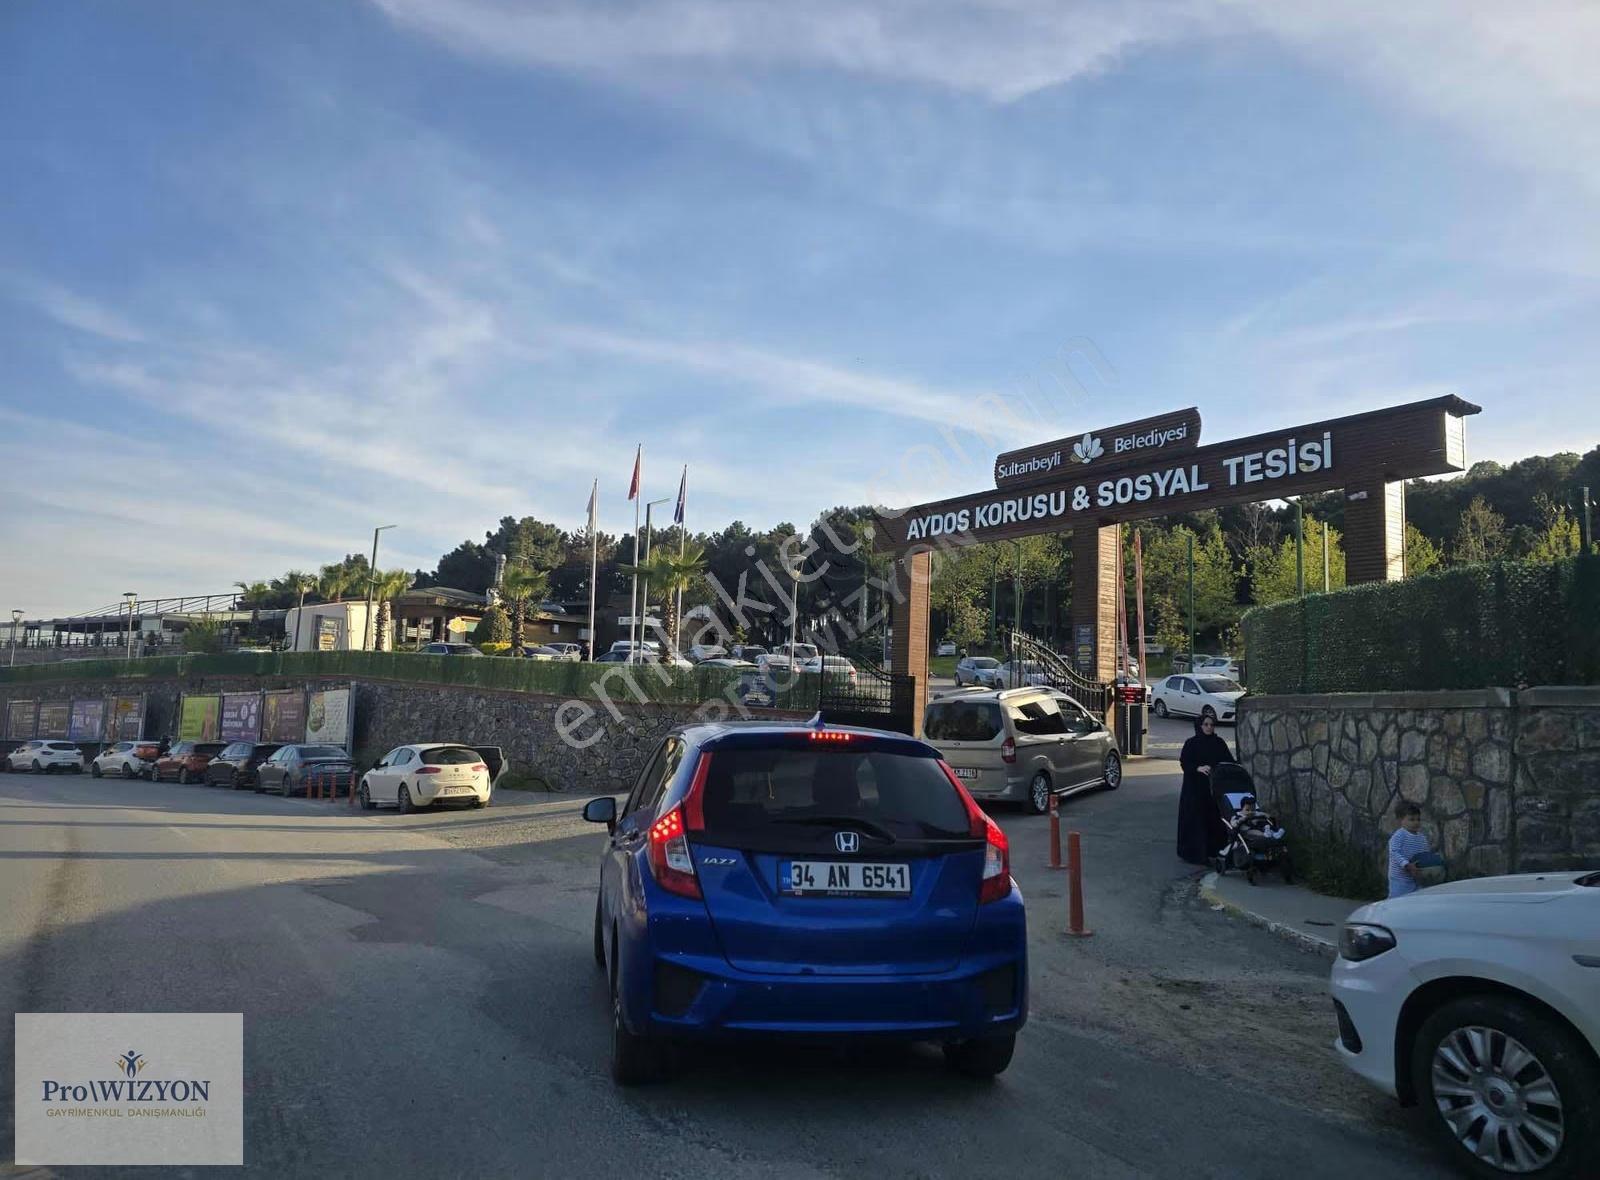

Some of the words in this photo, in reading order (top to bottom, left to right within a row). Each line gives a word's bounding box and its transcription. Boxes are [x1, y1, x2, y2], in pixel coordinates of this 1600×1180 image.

[998, 451, 1061, 479] Sultanbeyli
[1114, 423, 1187, 453] Belediyesi
[907, 508, 970, 541] AYDOS
[974, 490, 1066, 529] KORUSU
[1071, 485, 1091, 511] &
[1096, 464, 1209, 507] SOSYAL
[1222, 431, 1332, 486] TESİSİ
[791, 864, 815, 888] 34
[827, 865, 850, 888] AN
[862, 865, 906, 889] 6541
